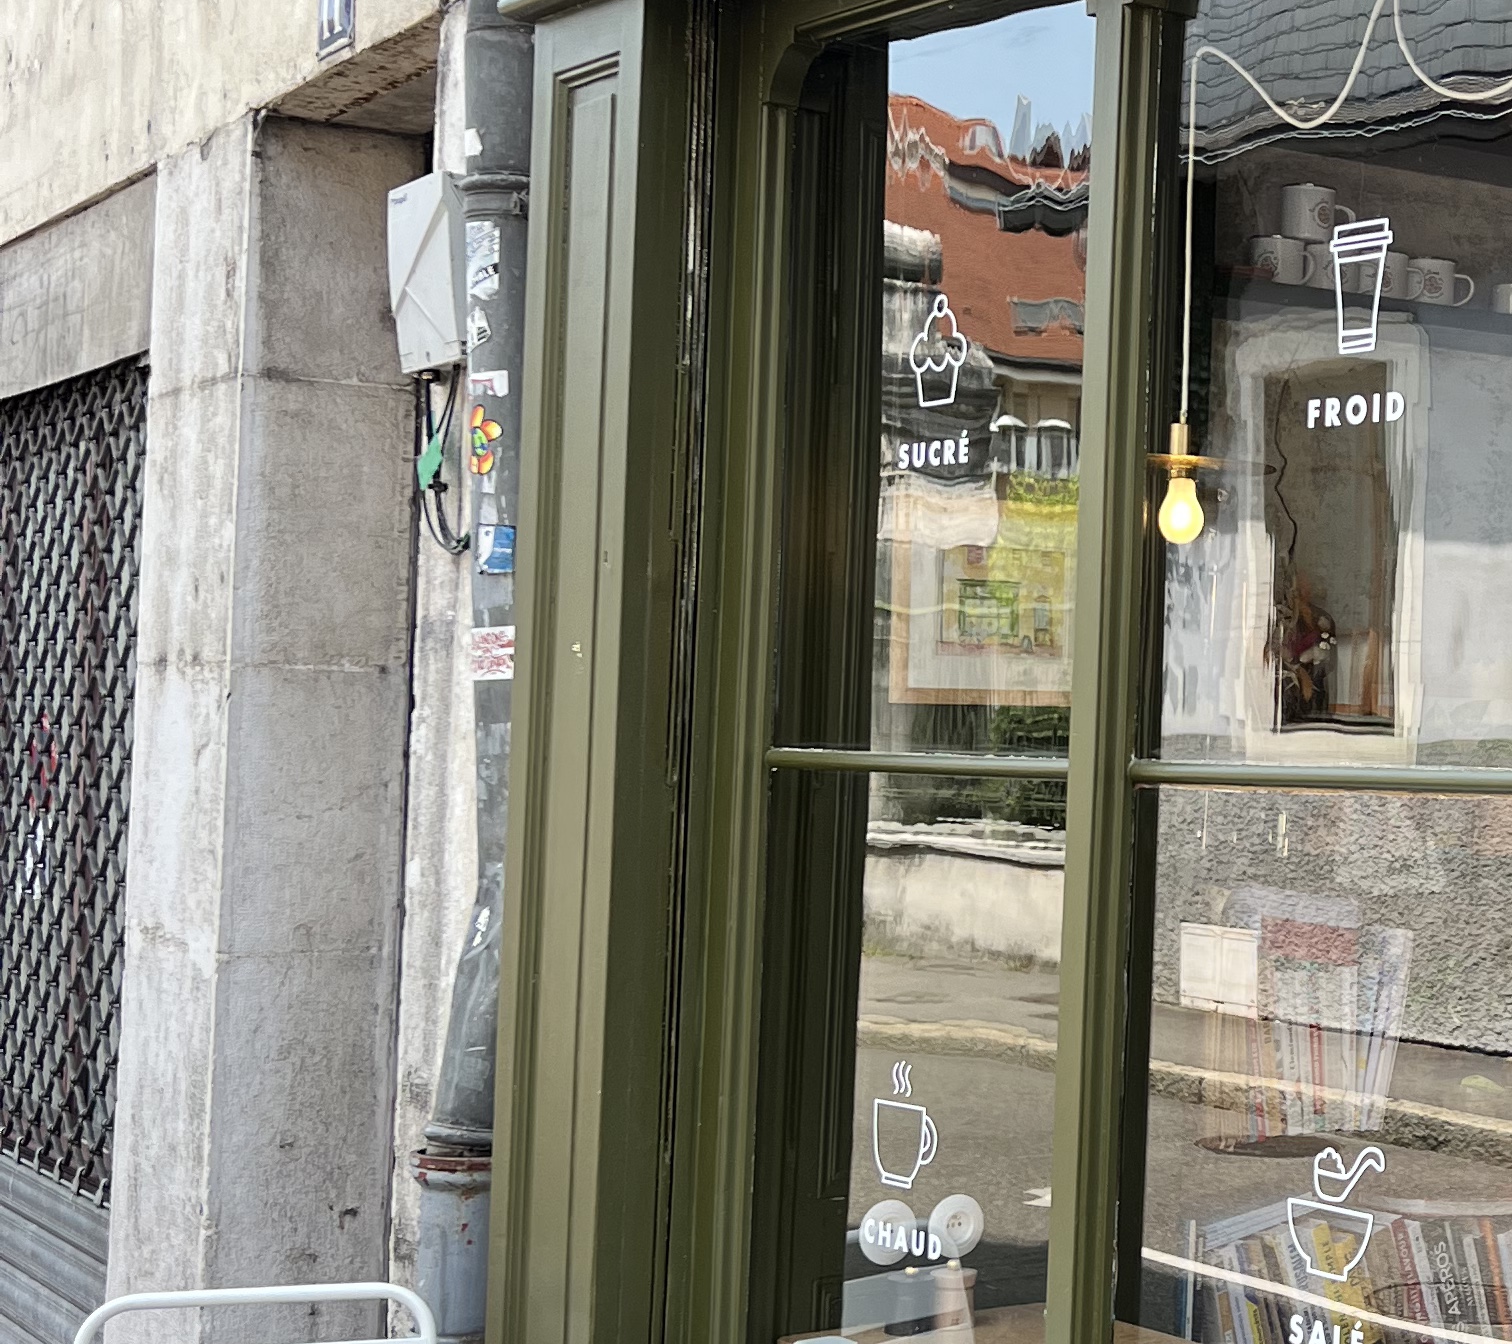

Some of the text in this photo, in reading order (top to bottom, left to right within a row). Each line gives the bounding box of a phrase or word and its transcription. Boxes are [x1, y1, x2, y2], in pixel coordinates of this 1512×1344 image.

[1306, 389, 1406, 430] FROID
[897, 429, 972, 471] SUCRÉ
[862, 1217, 944, 1261] CHAUD
